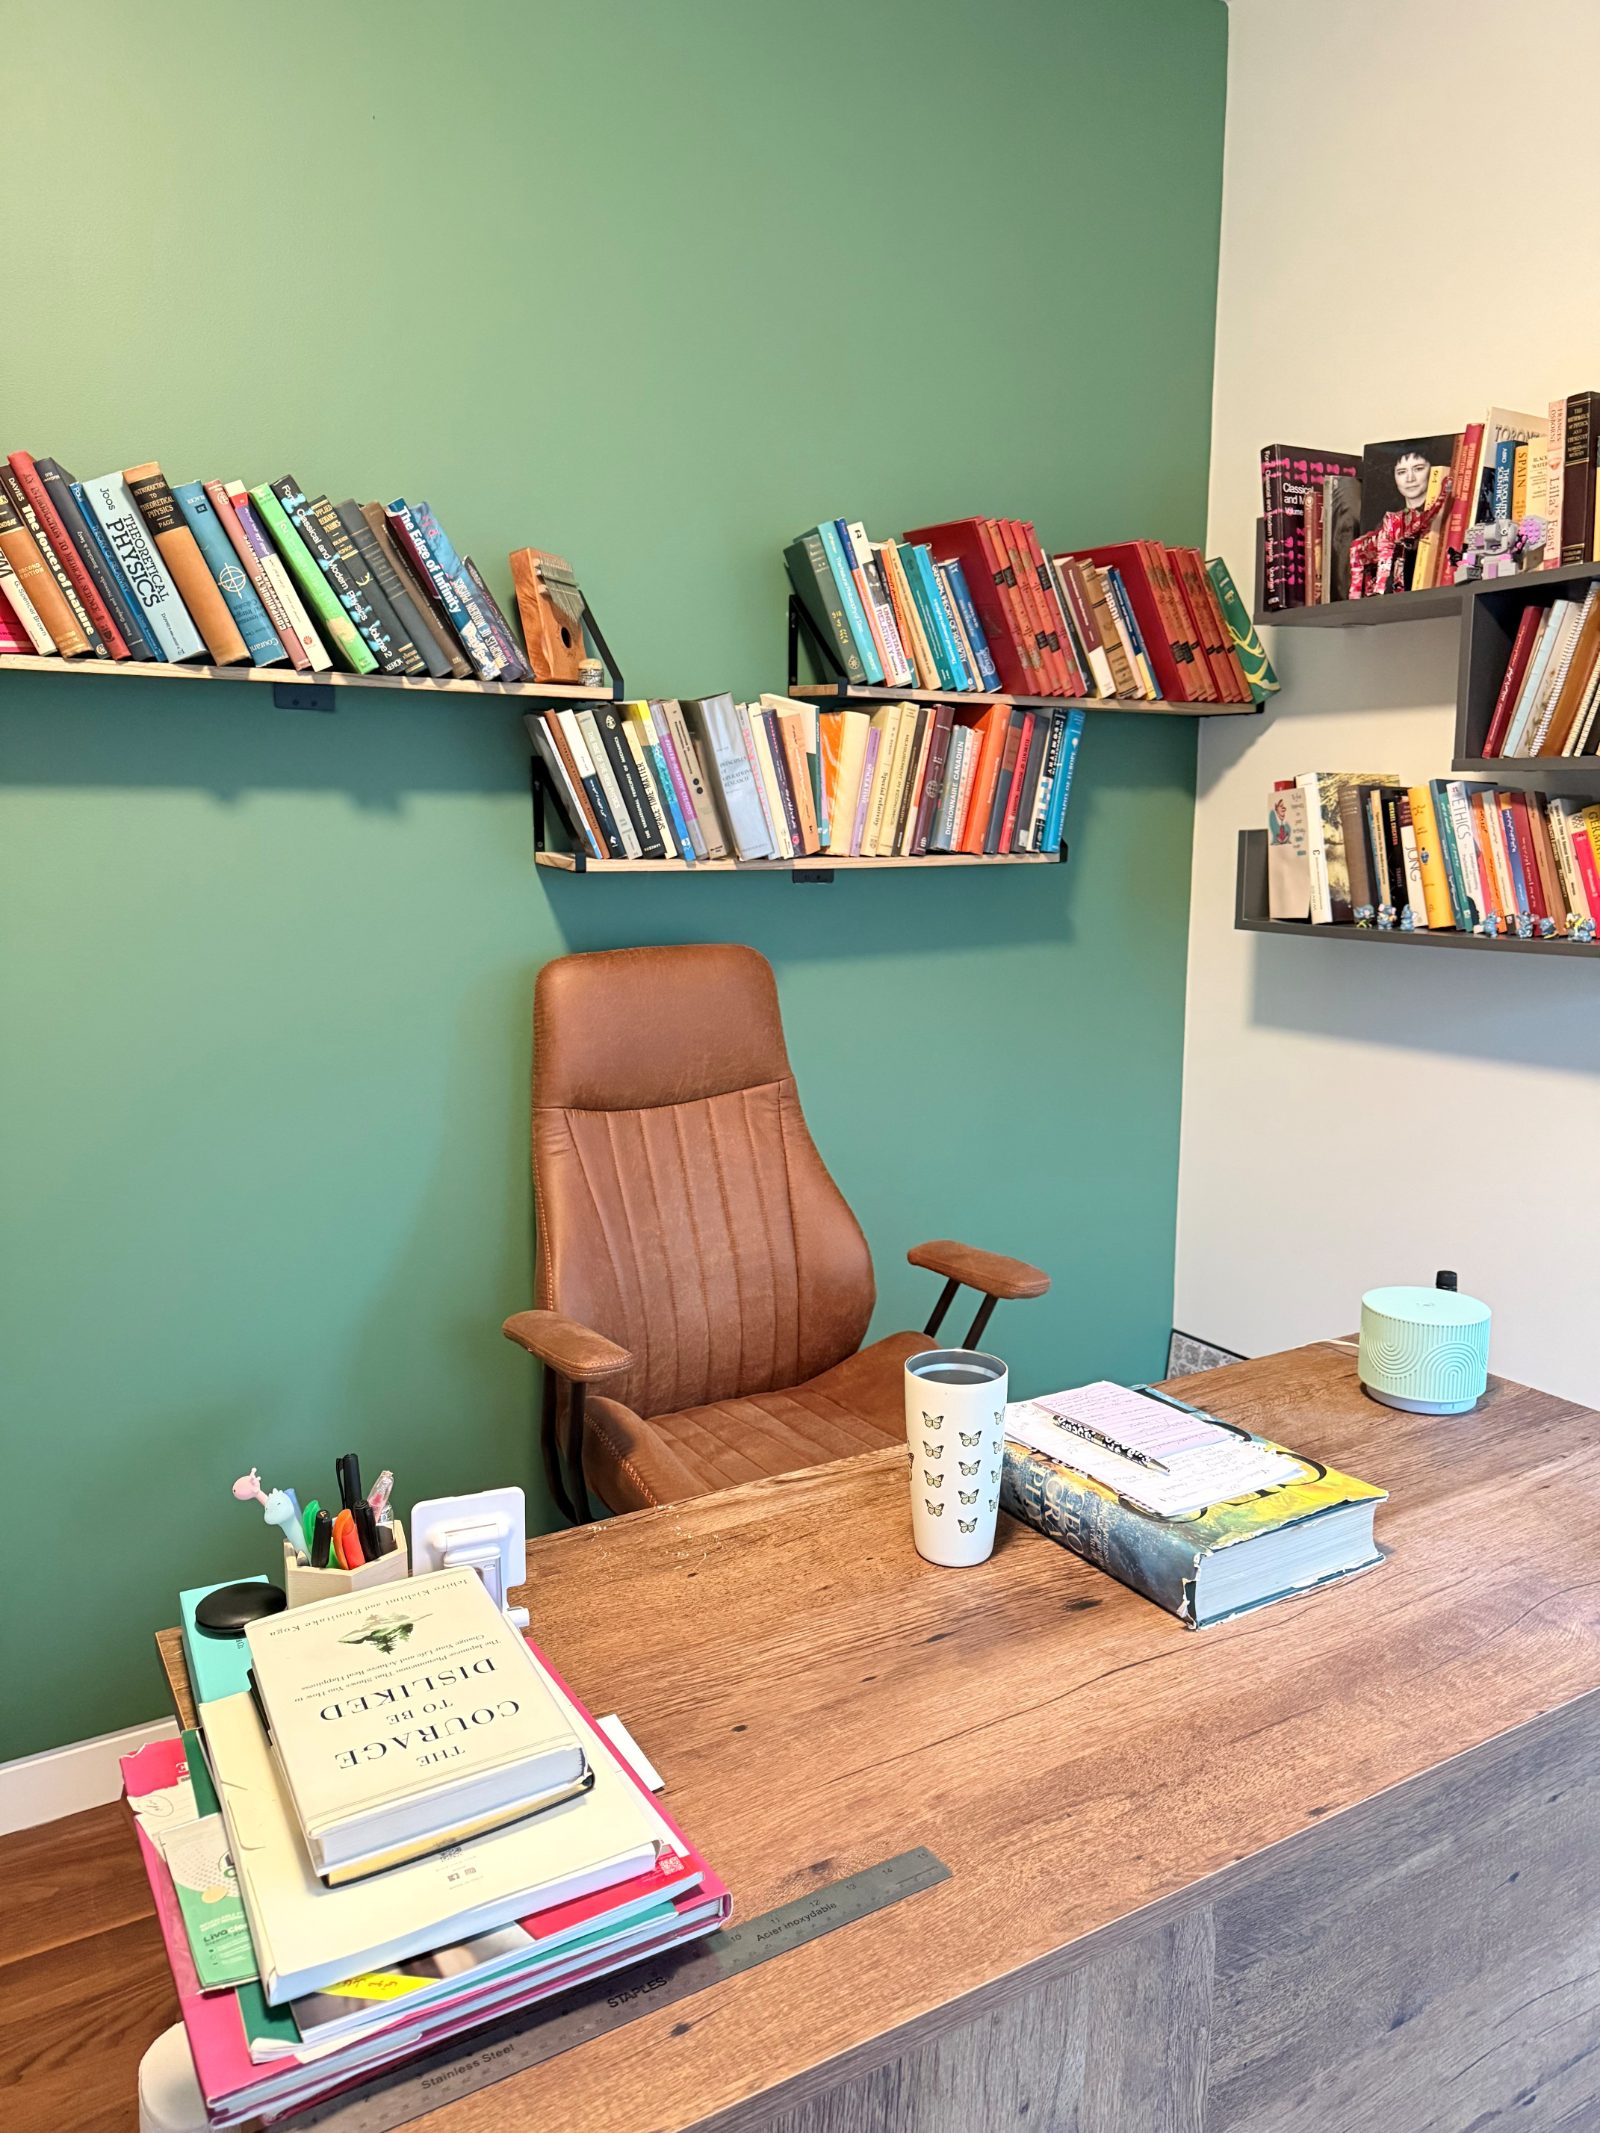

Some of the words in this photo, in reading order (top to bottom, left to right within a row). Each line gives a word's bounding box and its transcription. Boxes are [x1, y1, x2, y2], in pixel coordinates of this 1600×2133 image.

[1518, 452, 1528, 488] SPAIN
[133, 480, 166, 495] INTRODUCTION
[1549, 477, 1561, 518] Lilla's
[139, 495, 174, 512] THEORETICAL
[1284, 494, 1297, 504] and
[146, 504, 174, 518] PHYSICS
[395, 505, 417, 531] The
[1285, 507, 1304, 516] Volume
[157, 518, 174, 528] PAGE
[1265, 512, 1273, 535] Modern
[23, 472, 34, 484] AN
[30, 485, 62, 539] INTRODUCTION
[58, 540, 68, 551] TO
[63, 551, 85, 584] MEDICAL
[80, 584, 101, 613] SCIENCE
[408, 529, 432, 560] Edge
[1547, 520, 1559, 552] Feast
[8, 477, 24, 502] DAVIES
[20, 503, 42, 532] The
[34, 529, 62, 572] forces
[56, 570, 71, 589] of
[64, 586, 96, 636] nature
[91, 524, 109, 550] THEORY
[104, 550, 113, 560] OF
[109, 559, 130, 593] RELATIVITY
[120, 513, 172, 602] THEORETICAL
[1266, 538, 1274, 562] Physics
[19, 566, 44, 580] EDITION
[104, 516, 162, 609] PHYSICS
[424, 557, 441, 574] of
[254, 574, 263, 585] TO
[295, 507, 322, 543] Classical
[316, 542, 332, 560] and
[326, 558, 351, 590] Modern
[344, 589, 369, 622] Physics
[367, 624, 389, 653] Volume
[383, 650, 392, 659] 2
[450, 576, 473, 603] PHYSICS
[430, 571, 464, 615] Infinity
[930, 563, 945, 595] GENERAL
[948, 619, 957, 630] OF
[18, 587, 36, 615] Spencer
[32, 614, 48, 636] Brown
[259, 584, 287, 630] COMPANION
[463, 600, 487, 628] MODERN
[932, 597, 942, 616] physics
[478, 625, 491, 638] OF
[874, 609, 896, 655] RELATIVITY
[879, 606, 909, 673] UNDERSTANDING
[249, 636, 278, 654] Courant
[483, 635, 510, 668] PRINCIPLES
[945, 639, 957, 664] Theoretical
[586, 731, 595, 742] THE
[1046, 719, 1060, 774] GEOMETRY
[590, 742, 600, 755] RISE
[595, 754, 603, 763] OF
[613, 736, 625, 762] MECHANICS
[598, 763, 607, 774] THE
[1065, 751, 1076, 779] EUROPE
[625, 772, 637, 797] PRINCIPLES
[877, 771, 888, 795] Special
[944, 782, 958, 835] DICTIONNAIRE
[952, 740, 964, 780] CANADIEN
[1064, 780, 1071, 790] OF
[607, 787, 620, 809] PHYSICS
[634, 798, 647, 828] VARIATIONAL
[872, 796, 883, 826] relativity
[1387, 801, 1396, 821] MICHAEL
[1449, 797, 1473, 840] ETHICS
[1389, 822, 1399, 845] CRICHTON
[1405, 846, 1420, 882] JUNG
[432, 1577, 468, 1594] Ichiro
[363, 1601, 382, 1613] and
[384, 1588, 431, 1608] Kishimi
[303, 1606, 363, 1630] Fumitake
[267, 1622, 301, 1639] Koga
[455, 1633, 485, 1647] Change
[415, 1648, 434, 1660] Life
[433, 1642, 454, 1653] Your
[447, 1642, 484, 1658] Japanese
[487, 1638, 502, 1648] The
[365, 1659, 398, 1675] Achieve
[393, 1653, 448, 1675] Phenomenon
[399, 1654, 416, 1664] and
[299, 1673, 345, 1693] Happiness
[345, 1668, 365, 1681] Real
[345, 1676, 373, 1690] Shows
[373, 1670, 394, 1682] That
[305, 1690, 326, 1702] How
[320, 1657, 499, 1722] DISLIKED
[326, 1684, 345, 1696] You
[386, 1709, 415, 1725] BE
[422, 1699, 453, 1714] TO
[334, 1698, 521, 1770] COURAGE
[416, 1745, 466, 1768] THE
[881, 1867, 893, 1876] 14
[845, 1882, 857, 1892] 13
[809, 1898, 820, 1908] 12
[756, 1924, 783, 1943] Acier
[785, 1901, 838, 1931] inoxydable
[730, 1932, 742, 1943] 10
[606, 1975, 668, 2009] STAPLES
[421, 2058, 481, 2090] Stainless
[482, 2043, 516, 2065] Steel
